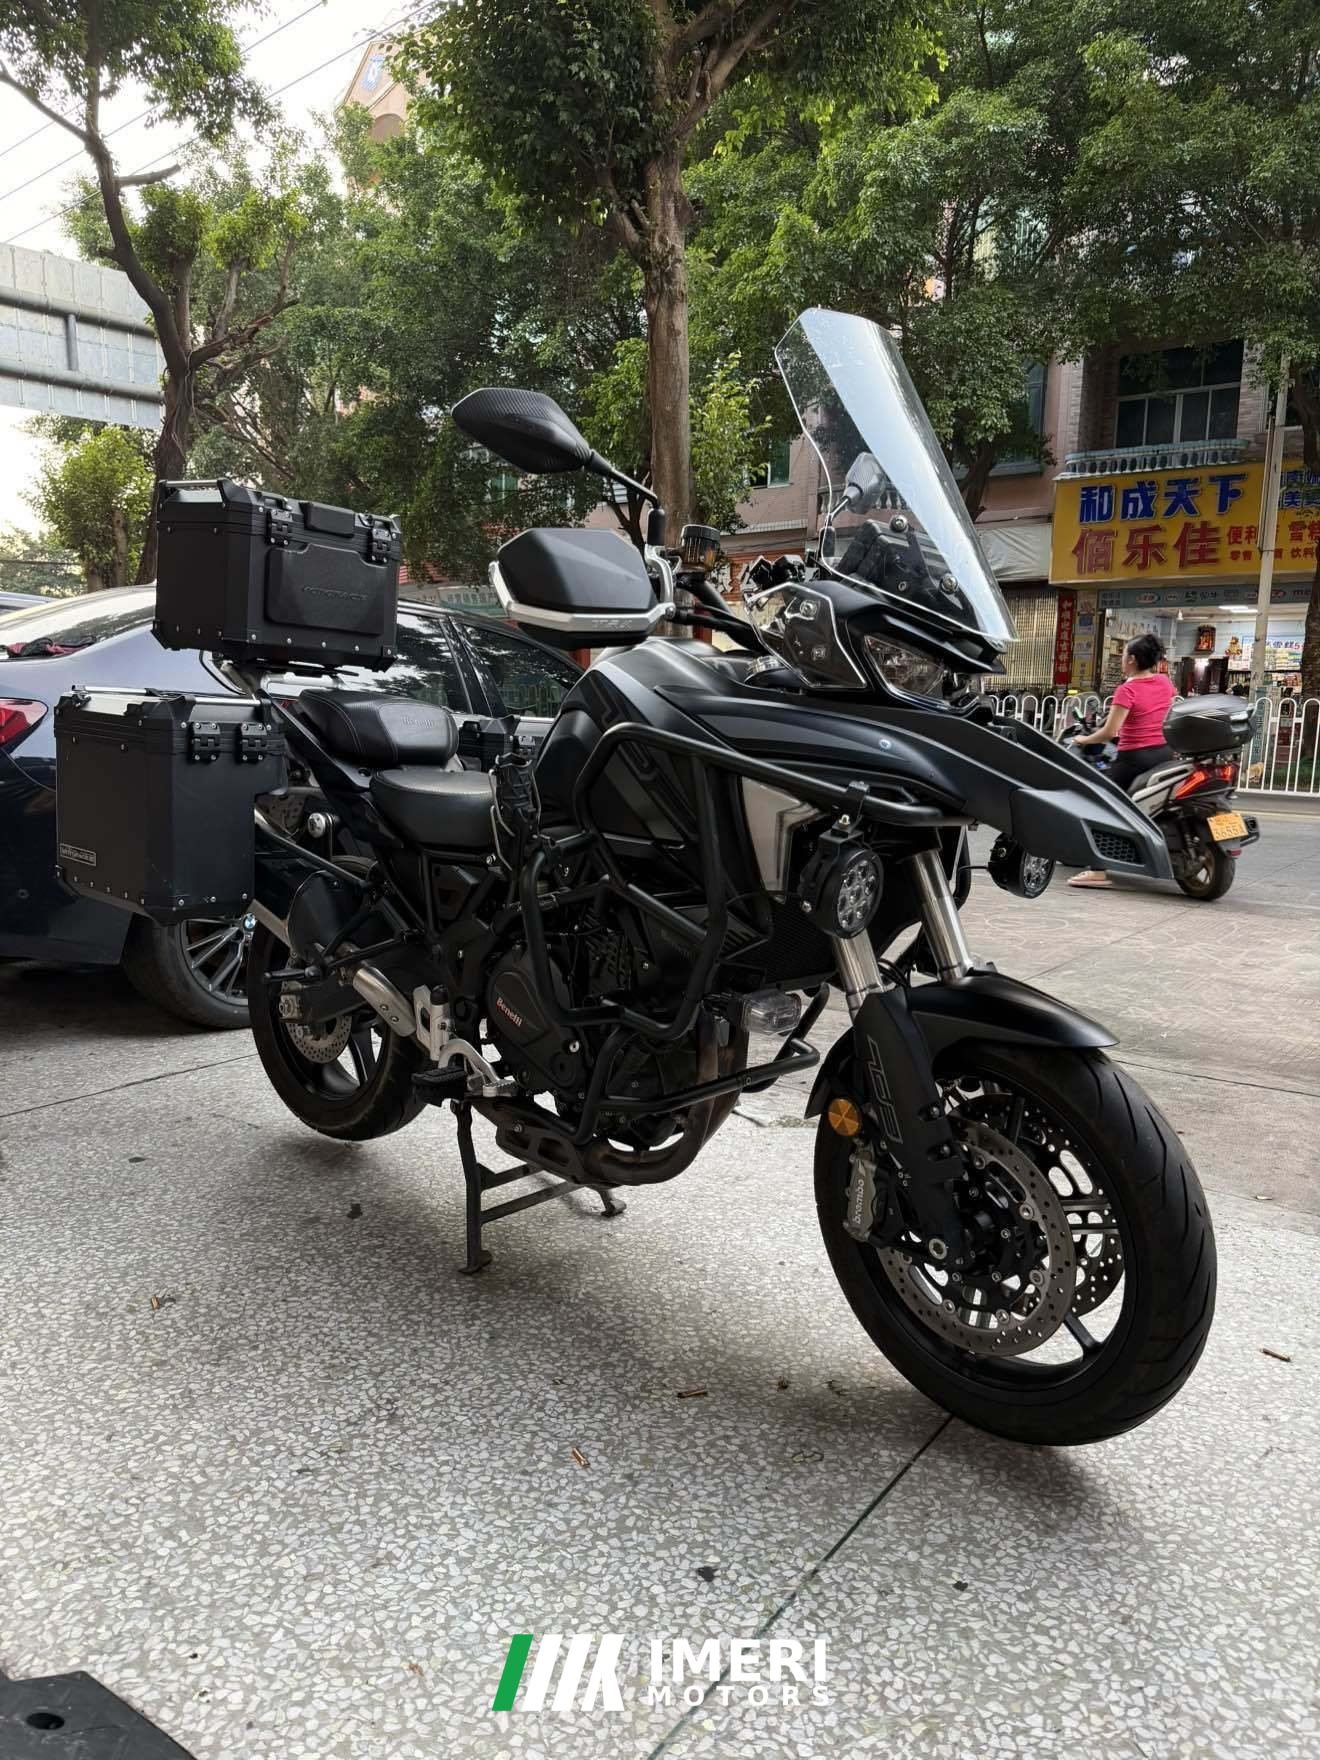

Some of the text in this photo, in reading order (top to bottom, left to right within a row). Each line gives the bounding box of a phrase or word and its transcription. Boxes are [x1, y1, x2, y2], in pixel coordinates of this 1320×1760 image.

[1079, 474, 1246, 524] 和成天下
[1071, 520, 1220, 575] 佰乐佳
[496, 996, 522, 1027] Benelli
[853, 1178, 865, 1225] brembo
